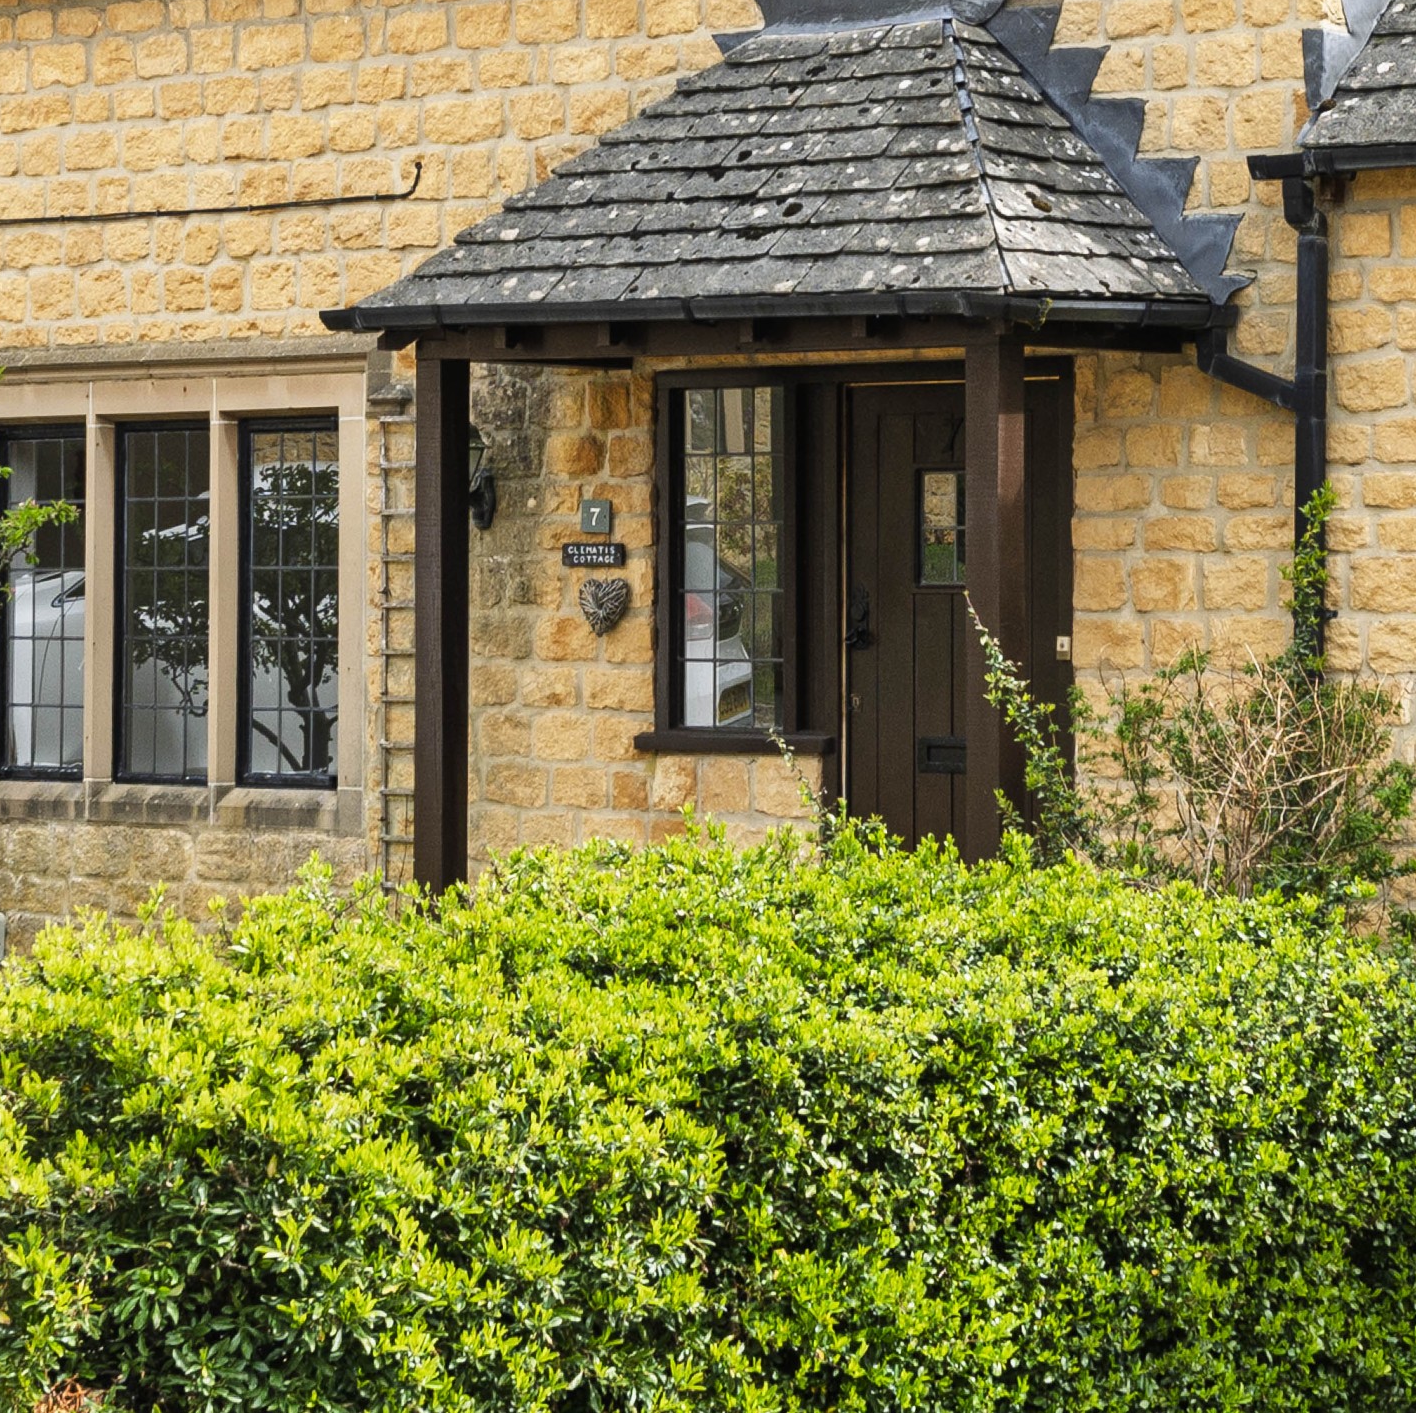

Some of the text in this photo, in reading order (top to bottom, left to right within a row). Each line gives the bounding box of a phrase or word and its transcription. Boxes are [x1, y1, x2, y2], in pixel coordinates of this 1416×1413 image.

[589, 507, 601, 526] 7
[567, 545, 615, 554] CLEMATIS
[573, 555, 615, 564] COTTAGE
